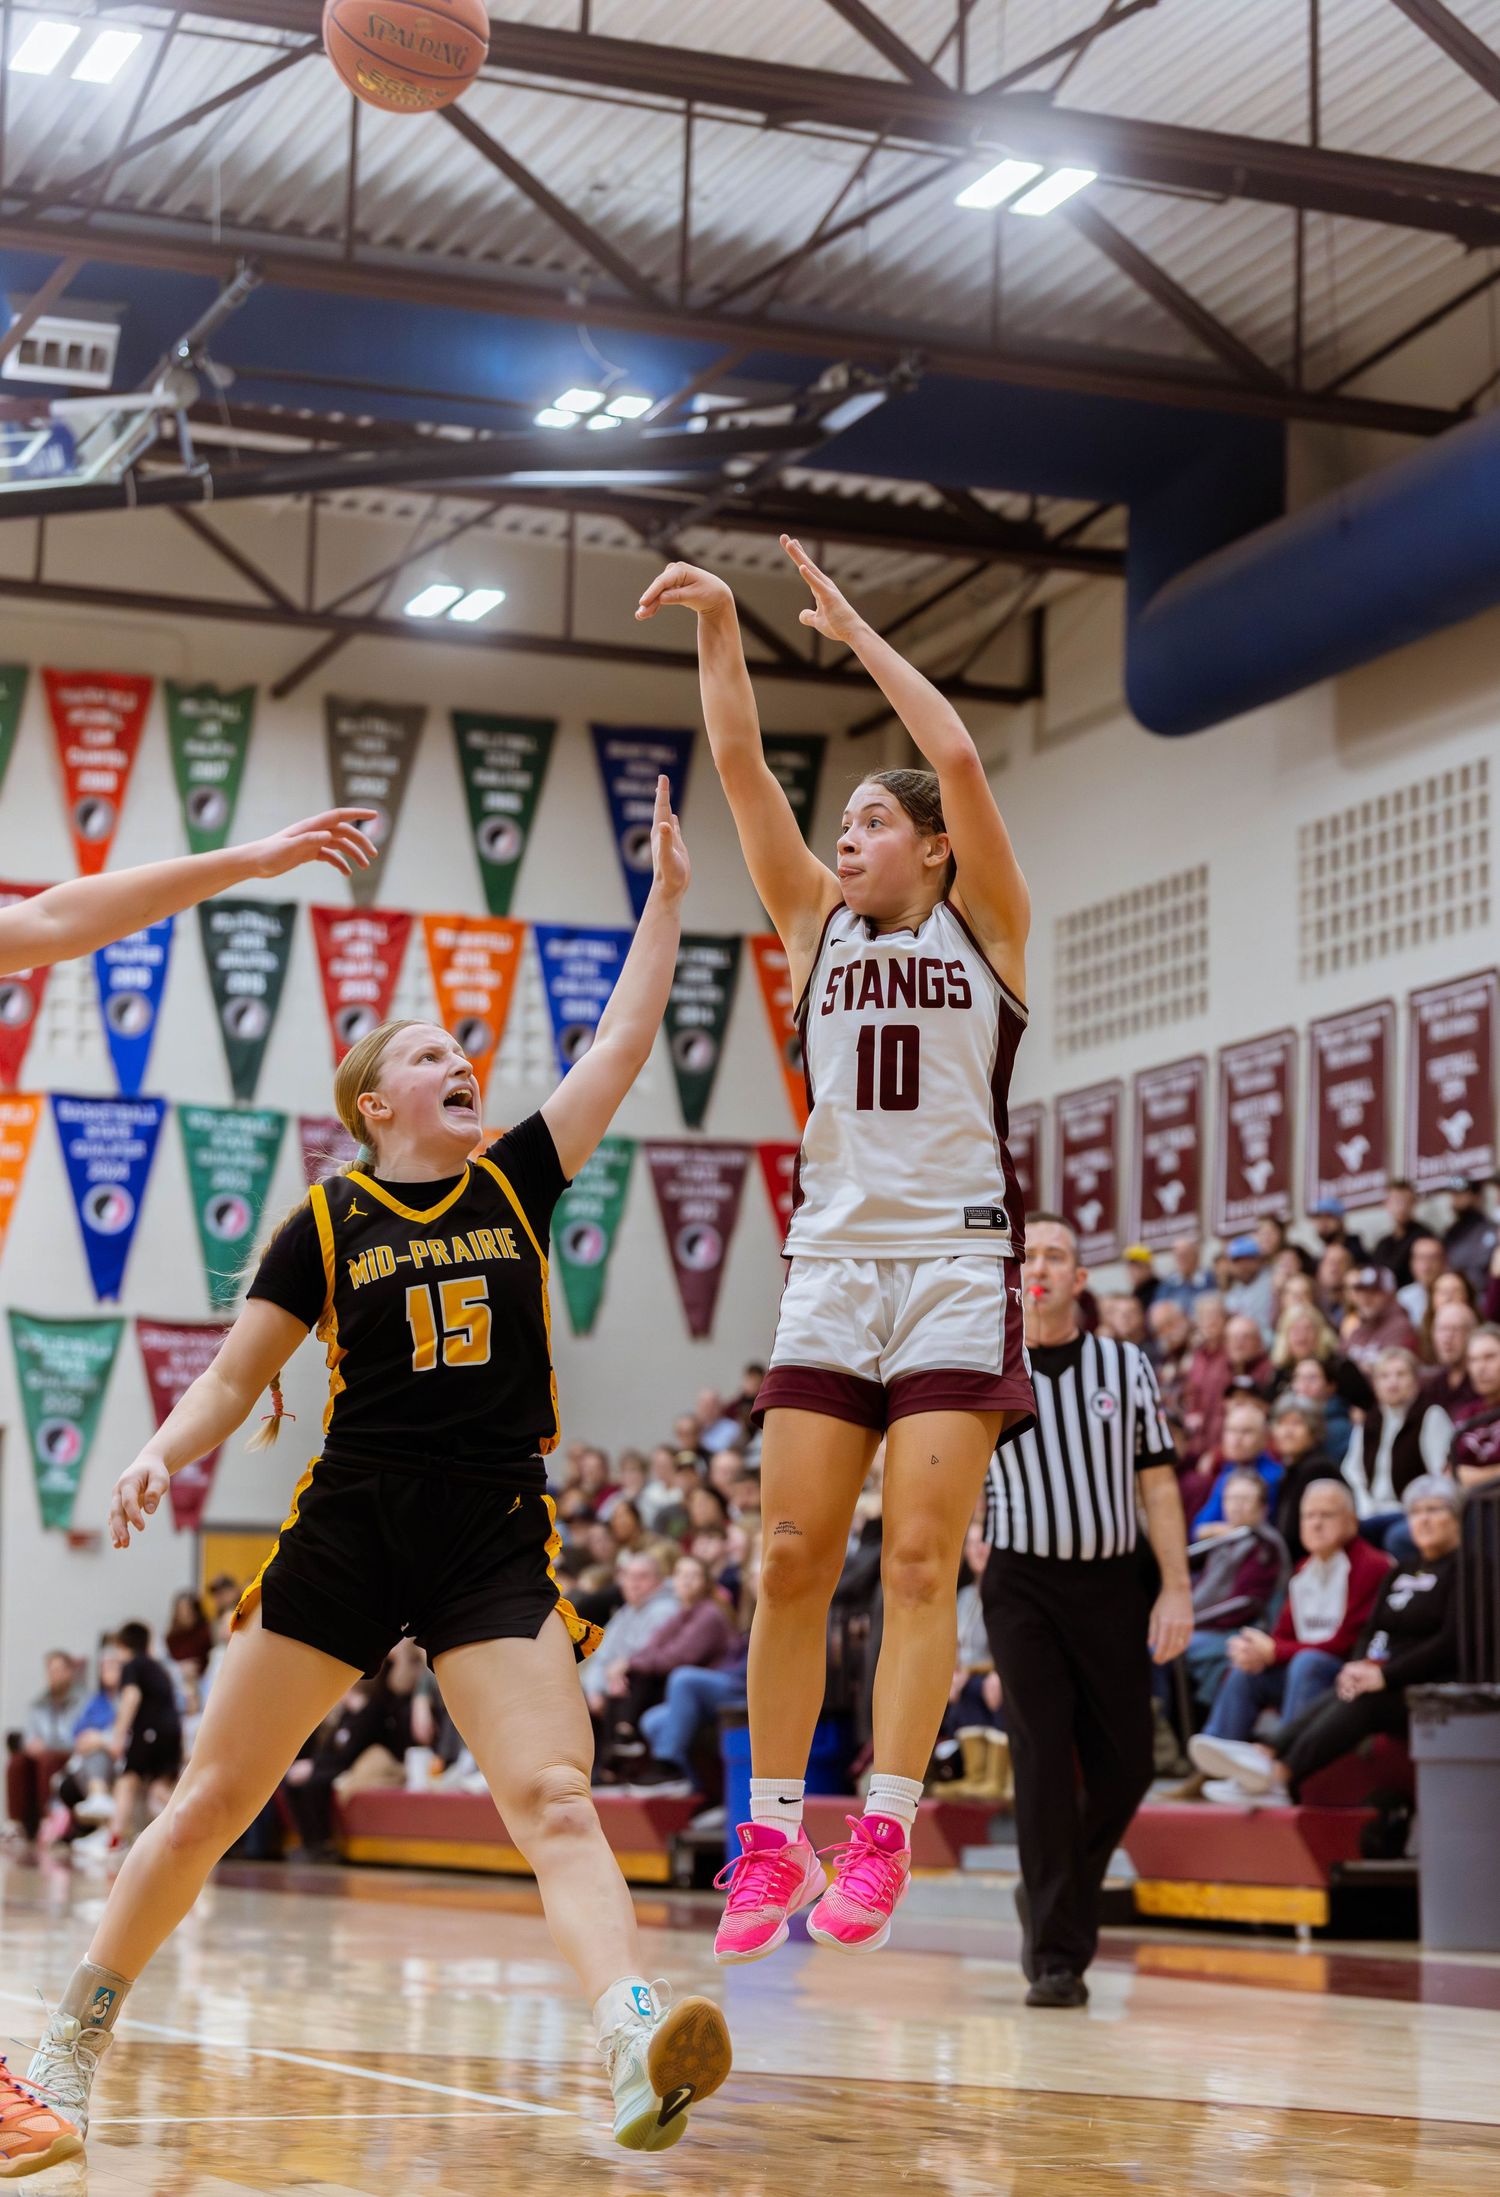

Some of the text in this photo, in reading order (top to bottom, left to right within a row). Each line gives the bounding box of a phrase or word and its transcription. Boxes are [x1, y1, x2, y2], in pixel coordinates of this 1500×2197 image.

[363, 12, 470, 71] SPALDING
[821, 957, 972, 1016] STANGS
[856, 1024, 920, 1111] 10
[996, 1213, 1002, 1223] S
[348, 1228, 521, 1290] MID-PRAIRIE
[405, 1275, 492, 1372] 15
